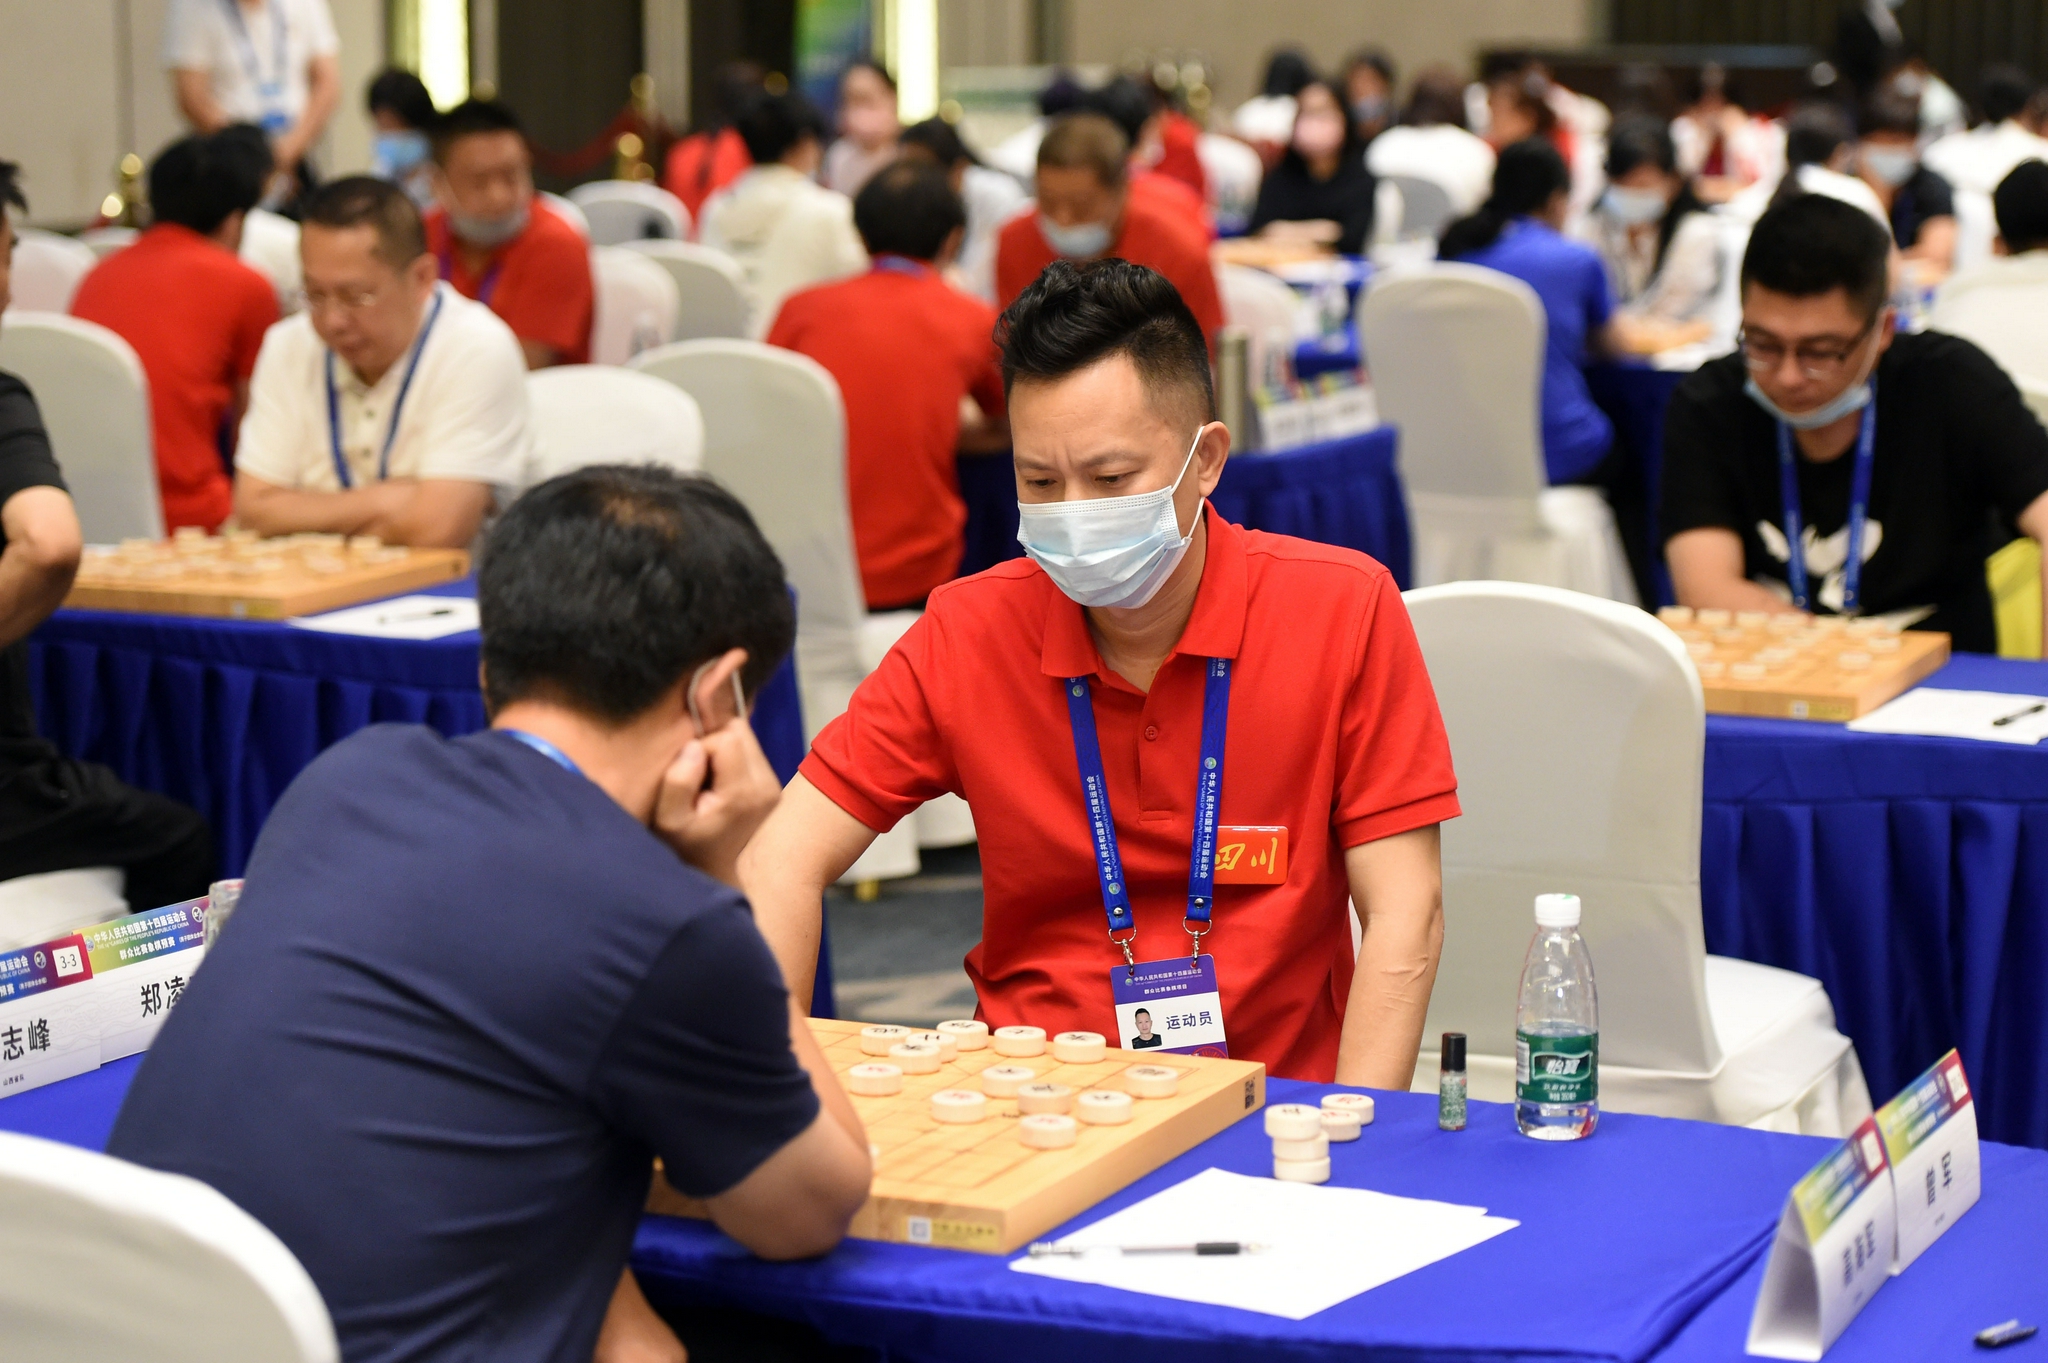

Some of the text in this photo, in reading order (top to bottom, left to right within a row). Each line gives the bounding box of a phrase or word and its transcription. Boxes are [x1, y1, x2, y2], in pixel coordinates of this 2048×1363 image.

[1200, 772, 1215, 878] 中华人民共和国第十四届运动会
[1215, 837, 1278, 875] 四川
[94, 910, 187, 943] 中华人民共和国第十四届运动会
[60, 953, 77, 969] 3-3
[141, 975, 192, 1018] 郑凌
[1, 1018, 51, 1060] 志峰
[1166, 1011, 1213, 1030] 运动员
